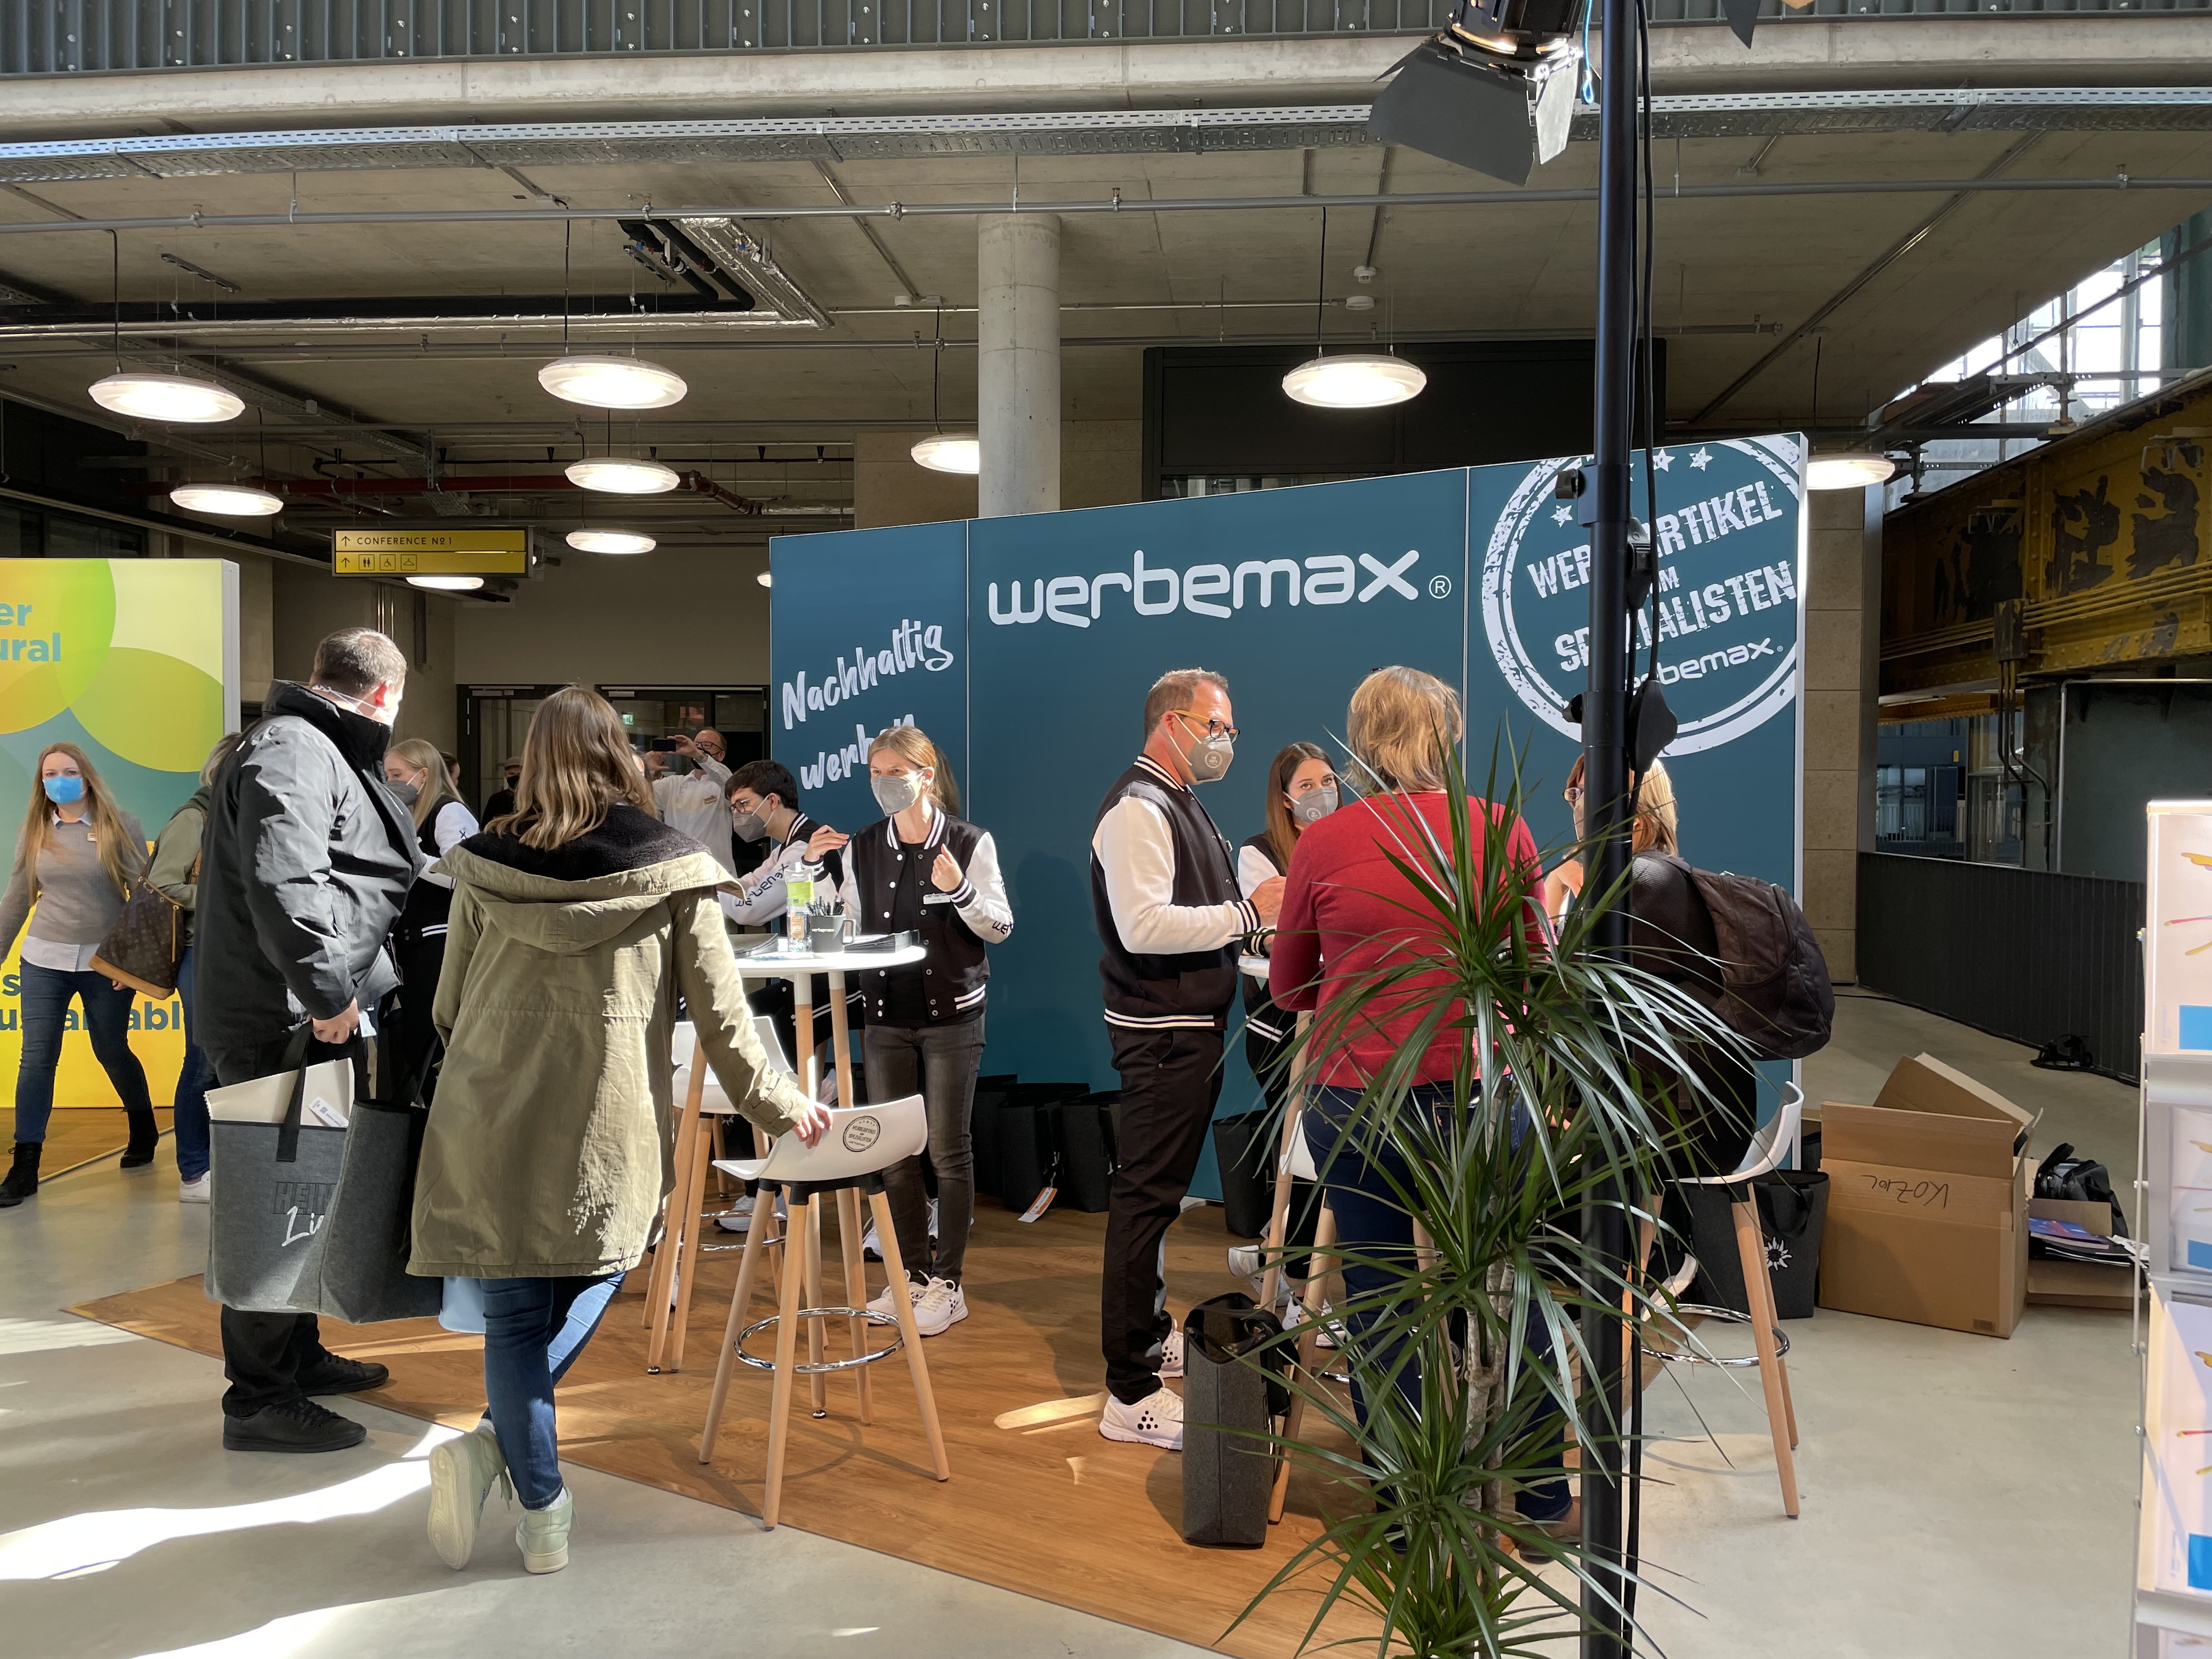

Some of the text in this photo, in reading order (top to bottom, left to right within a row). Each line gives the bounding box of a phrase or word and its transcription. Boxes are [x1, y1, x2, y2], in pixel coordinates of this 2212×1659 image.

[357, 537, 427, 545] CONFERENCE
[988, 550, 1420, 628] werbemax
[782, 619, 954, 730] Nachhaltig
